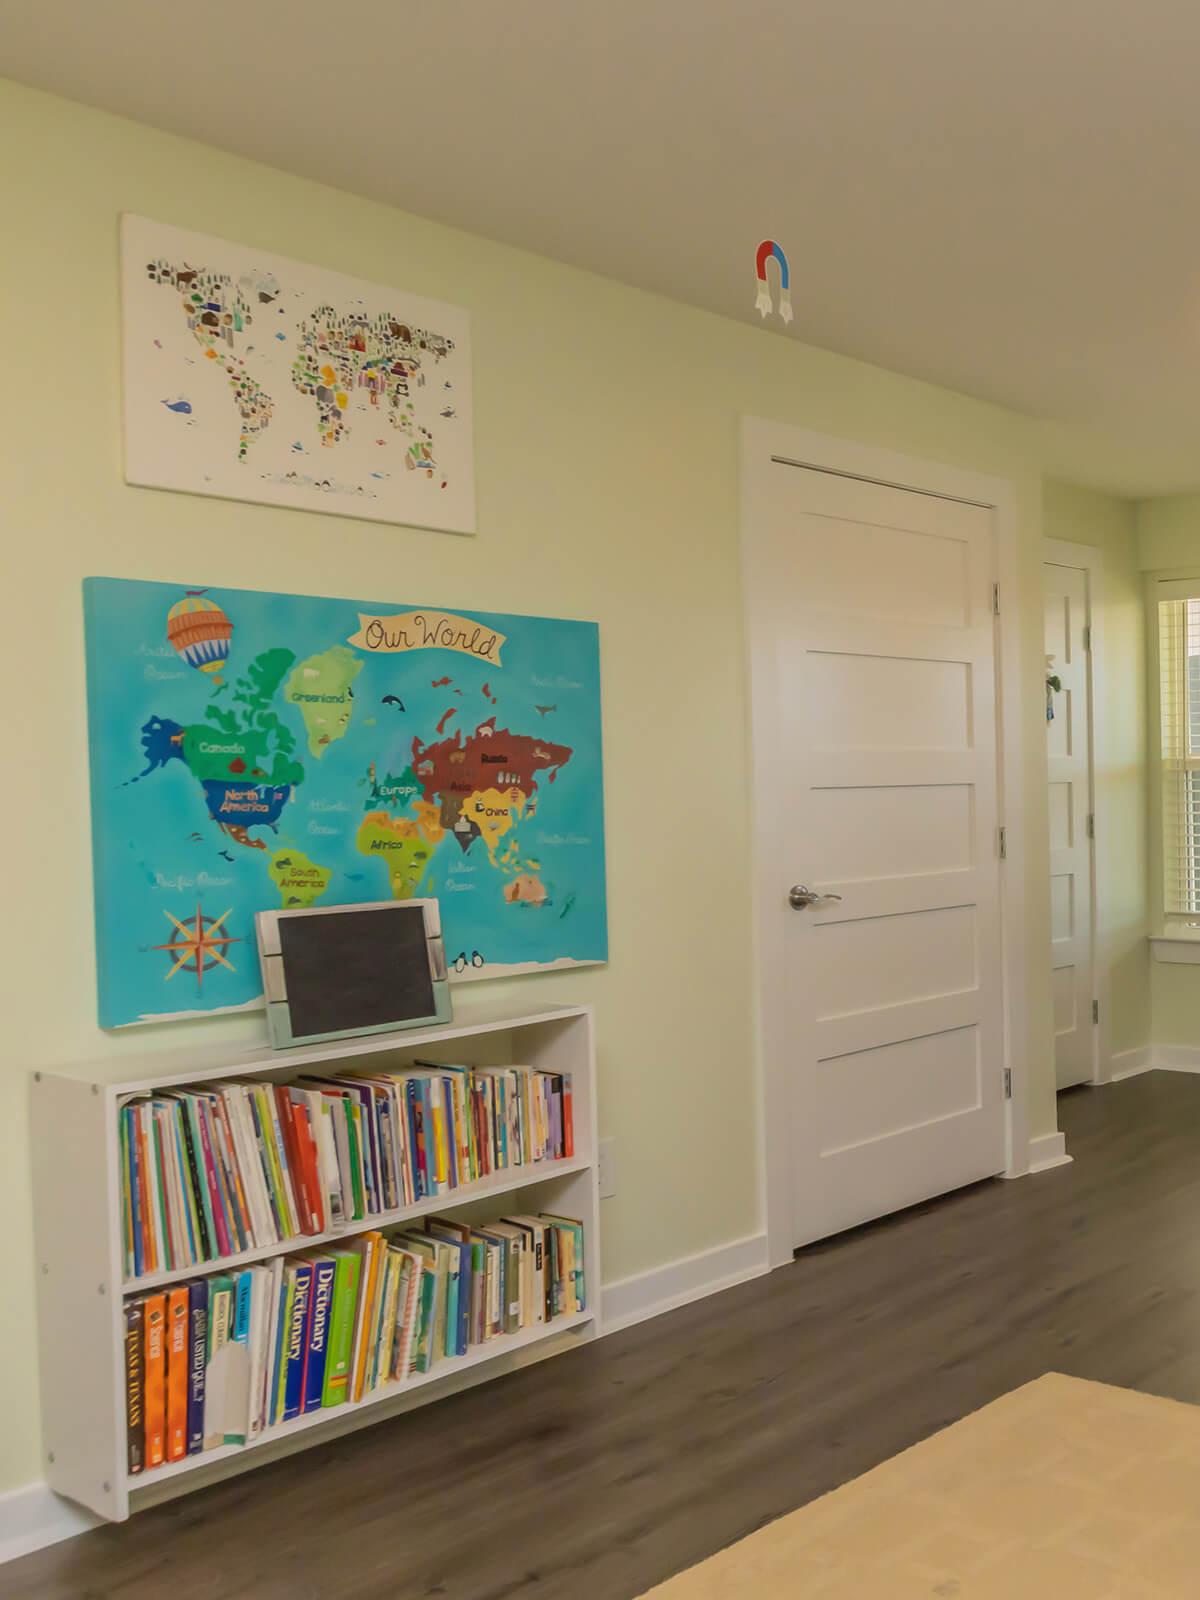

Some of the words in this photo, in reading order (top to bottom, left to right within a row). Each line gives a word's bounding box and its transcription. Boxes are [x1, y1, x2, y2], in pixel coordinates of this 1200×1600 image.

[366, 619, 415, 649] Our
[414, 615, 497, 660] World
[292, 692, 346, 704] Greenland
[199, 742, 246, 755] Canada
[224, 788, 259, 801] North
[379, 785, 418, 797] Europe
[219, 801, 270, 814] America
[485, 808, 509, 818] China
[370, 839, 403, 850] Africa
[289, 866, 320, 878] South
[279, 877, 326, 889] America
[310, 1267, 335, 1353] Dictionary
[289, 1275, 312, 1361] Dictionary
[127, 1329, 140, 1368] TEXAS
[129, 1380, 141, 1428] TEXANS
